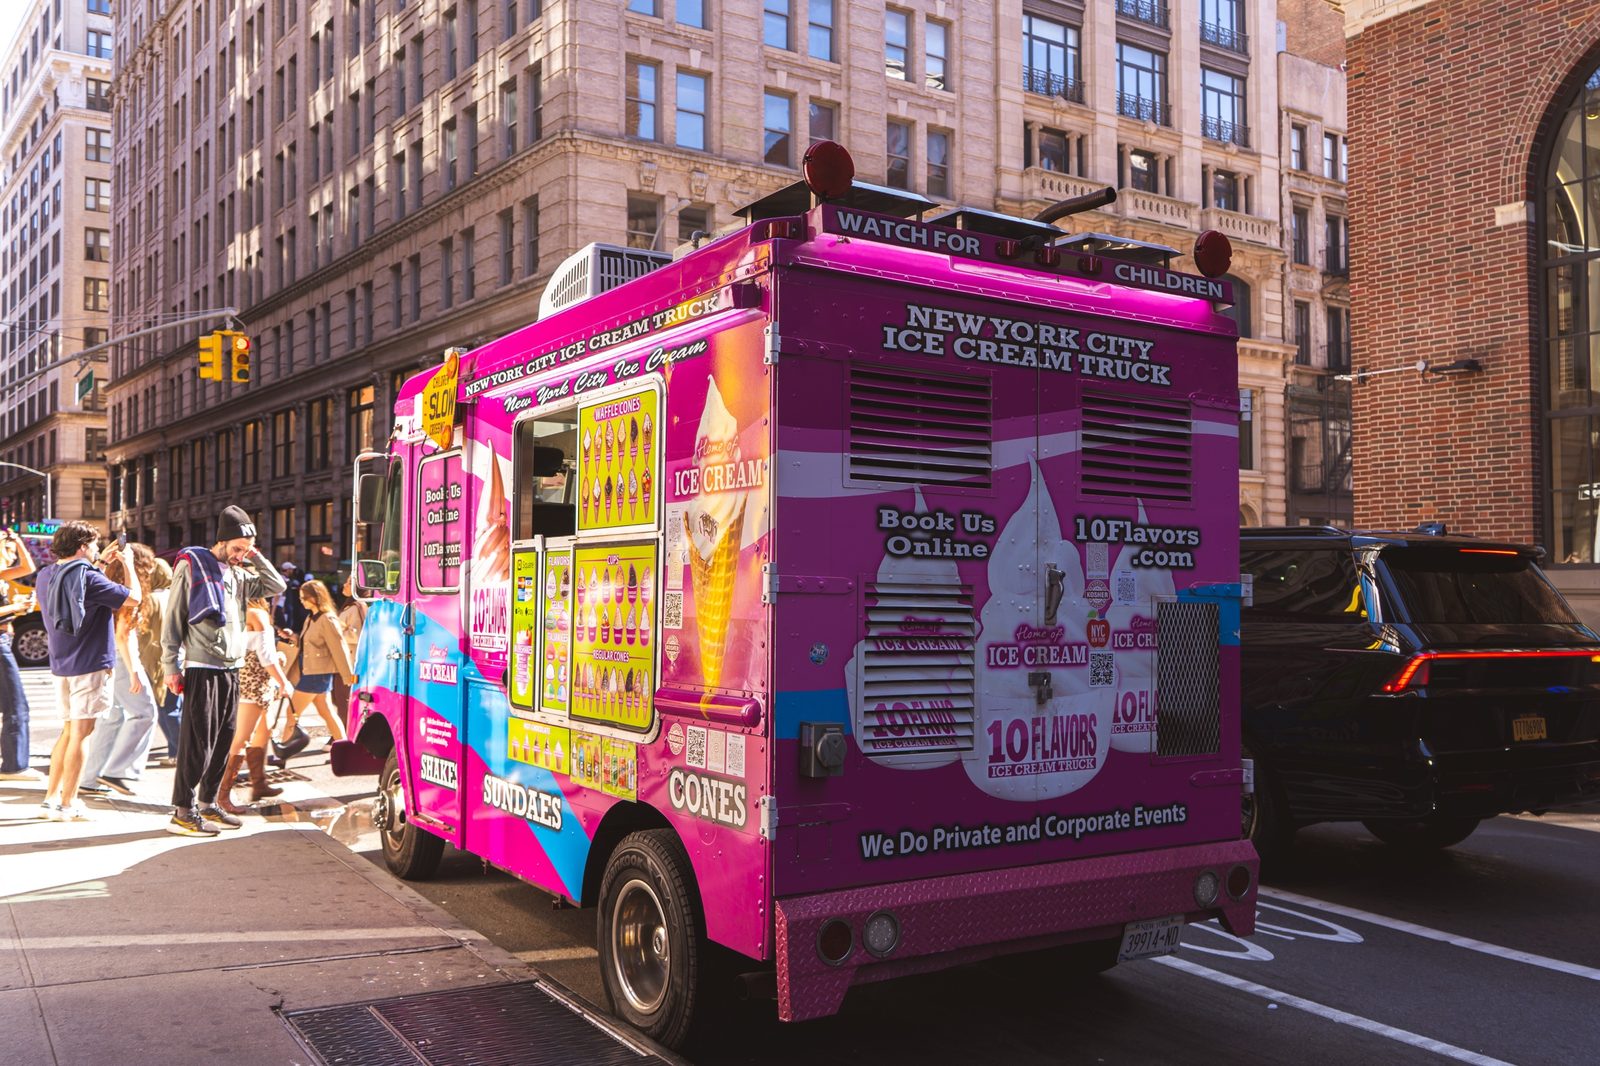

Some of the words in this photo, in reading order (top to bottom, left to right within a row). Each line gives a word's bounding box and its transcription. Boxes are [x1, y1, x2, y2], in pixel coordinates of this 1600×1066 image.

[837, 211, 928, 246] WATCH
[934, 230, 980, 255] FOR
[1114, 264, 1223, 298] CHILDREN
[906, 304, 987, 336] NEW
[989, 317, 1080, 349] YORK
[1086, 332, 1154, 360] CITY
[465, 378, 491, 397] NEW
[491, 366, 524, 385] YORK
[526, 355, 558, 376] CITY
[559, 340, 587, 362] ICE
[588, 319, 650, 351] CREAM
[652, 297, 720, 329] TRUCK
[883, 326, 945, 355] ICE
[953, 337, 1072, 372] CREAM
[1078, 354, 1171, 386] TRUCK
[503, 394, 532, 413] New
[536, 379, 570, 405] York
[573, 370, 608, 395] City
[614, 359, 640, 378] Ice
[644, 339, 708, 372] Cream
[429, 386, 456, 420] SLOW
[595, 401, 619, 421] WAFFLE
[620, 397, 641, 415] CONES
[697, 438, 723, 458] Home
[727, 435, 739, 457] of
[674, 468, 700, 496] ICE
[703, 459, 763, 492] CREAM
[450, 484, 461, 498] Us
[879, 509, 955, 531] Book
[962, 513, 995, 532] Us
[1076, 518, 1199, 545] 10Flavors
[887, 536, 988, 557] Online
[548, 556, 570, 567] FLAVORS
[607, 554, 620, 565] CUPS
[1133, 550, 1194, 567] .com
[1086, 590, 1109, 599] KOSHER
[1016, 627, 1046, 640] Home
[1050, 628, 1064, 643] of
[1090, 624, 1106, 638] NYC
[1113, 633, 1134, 648] ICE
[879, 637, 905, 651] ICE
[906, 637, 962, 651] CREAM
[989, 647, 1019, 666] ICE
[1023, 645, 1087, 666] CREAM
[593, 650, 613, 661] REGULAR
[613, 652, 630, 662] CONES
[420, 662, 431, 681] ICE
[432, 663, 457, 684] CREAM
[872, 702, 911, 738] 10
[986, 719, 1029, 764] 10
[1031, 713, 1097, 761] FLAVORS
[992, 765, 1012, 777] ICE
[1014, 760, 1056, 775] CREAM
[1058, 757, 1095, 772] TRUCK
[483, 774, 562, 830] SUNDAES
[669, 769, 746, 827] CONES
[861, 835, 894, 858] We
[900, 831, 928, 854] Do
[933, 826, 1001, 850] Private
[1005, 817, 1040, 843] and
[1045, 810, 1130, 838] Corporate
[1134, 804, 1186, 827] Events
